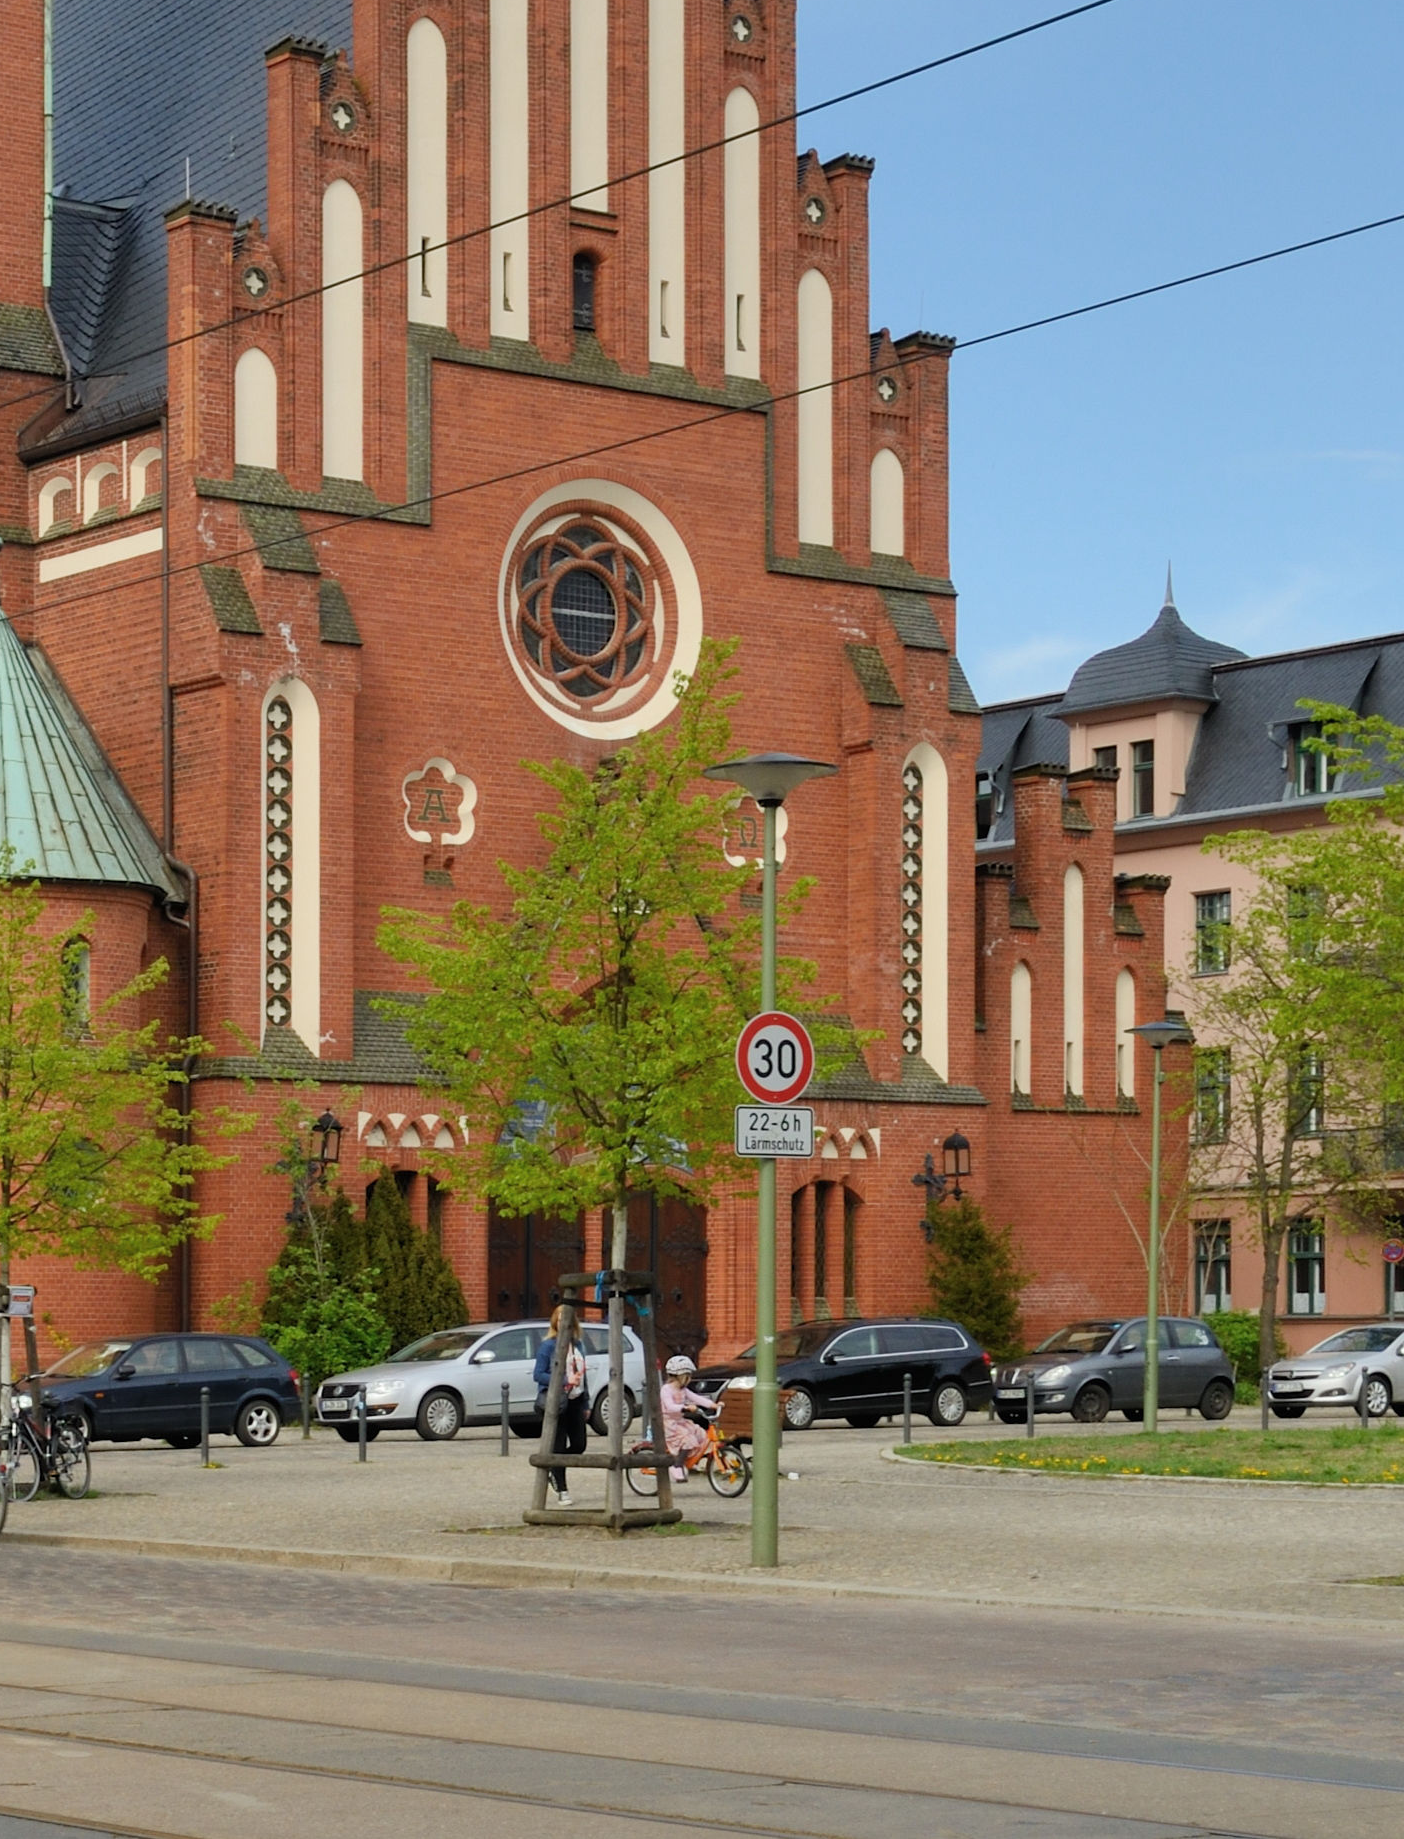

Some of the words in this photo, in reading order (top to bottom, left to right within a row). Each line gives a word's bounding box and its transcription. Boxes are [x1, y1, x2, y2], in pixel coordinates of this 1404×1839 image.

[417, 788, 451, 823] A
[754, 1038, 796, 1079] 30
[745, 1135, 805, 1151] Lärmschutz
